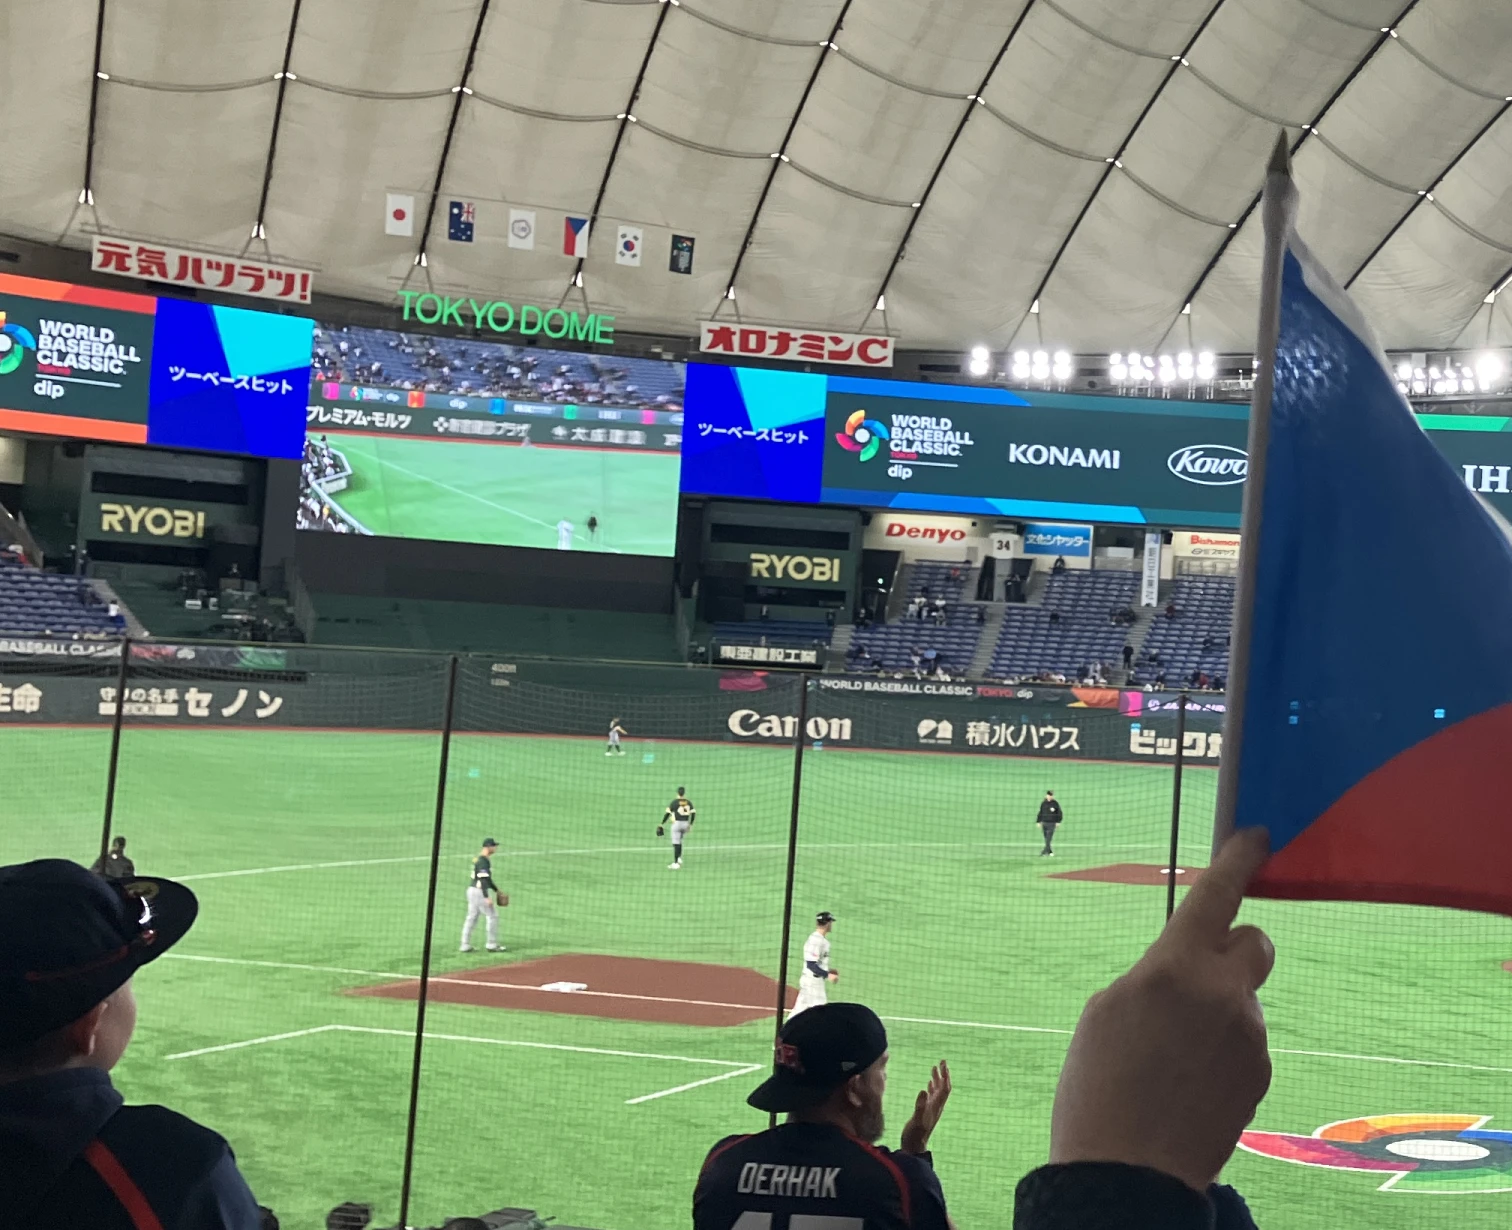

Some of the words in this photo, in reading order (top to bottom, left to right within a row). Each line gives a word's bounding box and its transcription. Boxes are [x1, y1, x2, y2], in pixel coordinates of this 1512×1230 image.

[97, 240, 310, 301] 元気ハツラツ!
[39, 319, 115, 342] WORLD
[398, 290, 514, 332] TOKYO
[520, 305, 615, 344] DOME
[38, 335, 141, 362] BASEBALL
[706, 326, 889, 365] オロナミンC
[34, 380, 64, 398] dip
[169, 366, 293, 395] ツーベースヒット
[698, 422, 809, 444] ツーベースヒット
[890, 427, 974, 445] BASEBALL
[891, 414, 953, 431] WORLD
[1009, 443, 1121, 470] KONAMI
[888, 464, 913, 480] dip
[101, 503, 205, 538] RYOBI
[885, 523, 966, 543] Denyo
[997, 540, 1011, 551] 34
[750, 552, 840, 583] RYOBI
[184, 687, 283, 718] セノン
[864, 681, 922, 694] BASEBALL
[924, 684, 973, 697] CLASSIC
[1017, 688, 1033, 700] dip
[729, 709, 852, 741] Canon
[966, 720, 1080, 750] 積水ハウス
